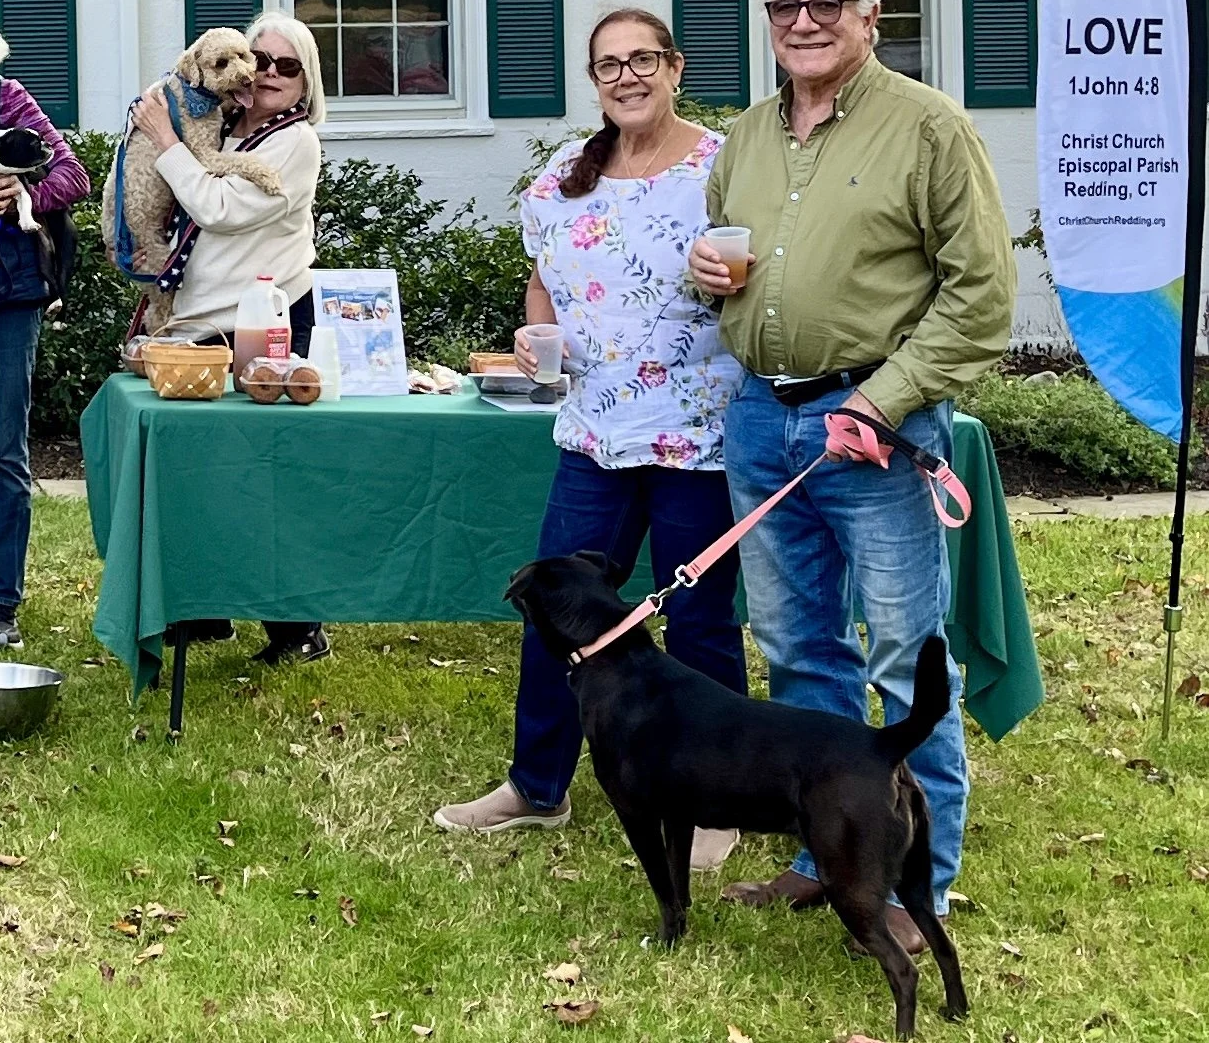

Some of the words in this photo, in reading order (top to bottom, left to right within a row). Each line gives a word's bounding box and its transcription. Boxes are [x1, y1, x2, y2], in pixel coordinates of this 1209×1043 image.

[1065, 17, 1164, 55] LOVE
[1069, 75, 1128, 95] 1John
[1134, 76, 1160, 96] 4:8
[1061, 133, 1109, 149] Christ
[1112, 133, 1165, 149] Church
[1058, 157, 1132, 177] Episcopal
[1137, 157, 1179, 173] Parish
[1064, 181, 1133, 201] Redding,
[1137, 181, 1158, 197] CT
[1058, 215, 1166, 228] ChristChurchRedding.org
